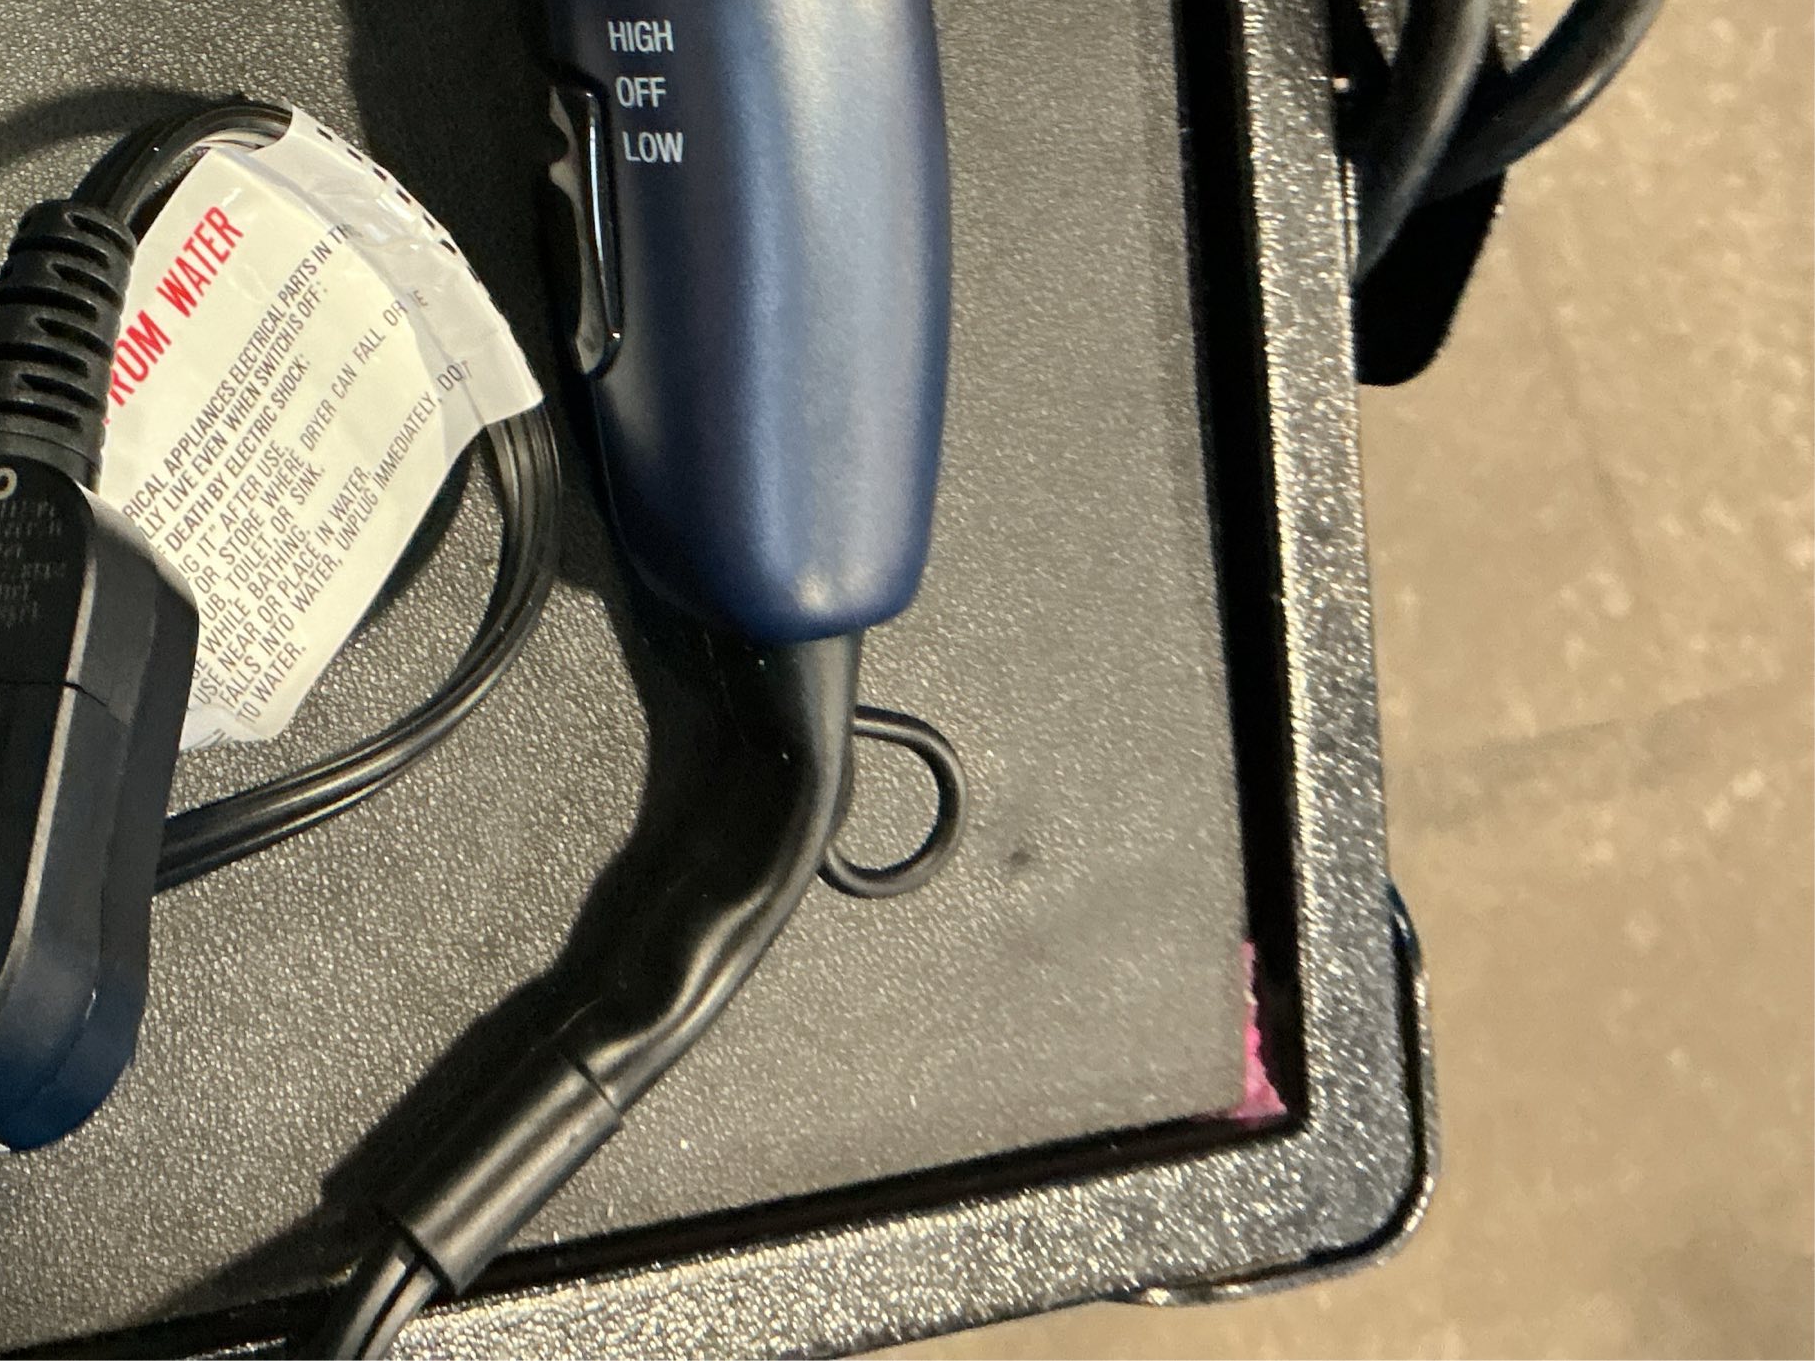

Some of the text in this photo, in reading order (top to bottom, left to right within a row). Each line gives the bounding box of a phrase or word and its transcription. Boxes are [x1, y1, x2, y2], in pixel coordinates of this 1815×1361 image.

[606, 19, 675, 54] HIGH
[614, 75, 667, 109] OFF
[621, 129, 684, 164] LOW
[104, 206, 244, 425] ROM WATER
[228, 303, 287, 385] ELECTRICAL
[277, 257, 318, 309] PARTS
[310, 239, 333, 265] IN
[162, 469, 200, 512] LIVE
[191, 429, 229, 477] EVEN
[222, 380, 262, 433] WHEN
[253, 328, 296, 387] SWITCH
[285, 312, 304, 336] IS
[164, 353, 311, 553] DEATH BY ELECTRIC SHOCK:
[194, 565, 221, 594] OR
[218, 508, 266, 565] STORE
[259, 449, 305, 509] WHERE
[299, 398, 338, 452] DRYER
[331, 362, 358, 400] CAN
[352, 328, 386, 365] FALL
[382, 299, 409, 327] OR
[219, 473, 263, 533] AFTER
[256, 440, 290, 478] USE.
[270, 505, 295, 535] OR
[289, 462, 326, 506] SINK.
[192, 667, 226, 705] USE
[217, 621, 263, 673] NEAR
[256, 594, 284, 624] OR
[276, 541, 322, 599] PLACE
[314, 519, 335, 546] IN
[327, 465, 372, 523] WATER.
[200, 597, 251, 655] WHILE
[247, 524, 311, 601] BATHING.
[218, 655, 262, 709] FALLS
[258, 612, 296, 657] INTO
[289, 553, 344, 614] WATER,
[334, 488, 379, 551] UNPLUG
[236, 641, 307, 725] TO WATER.
